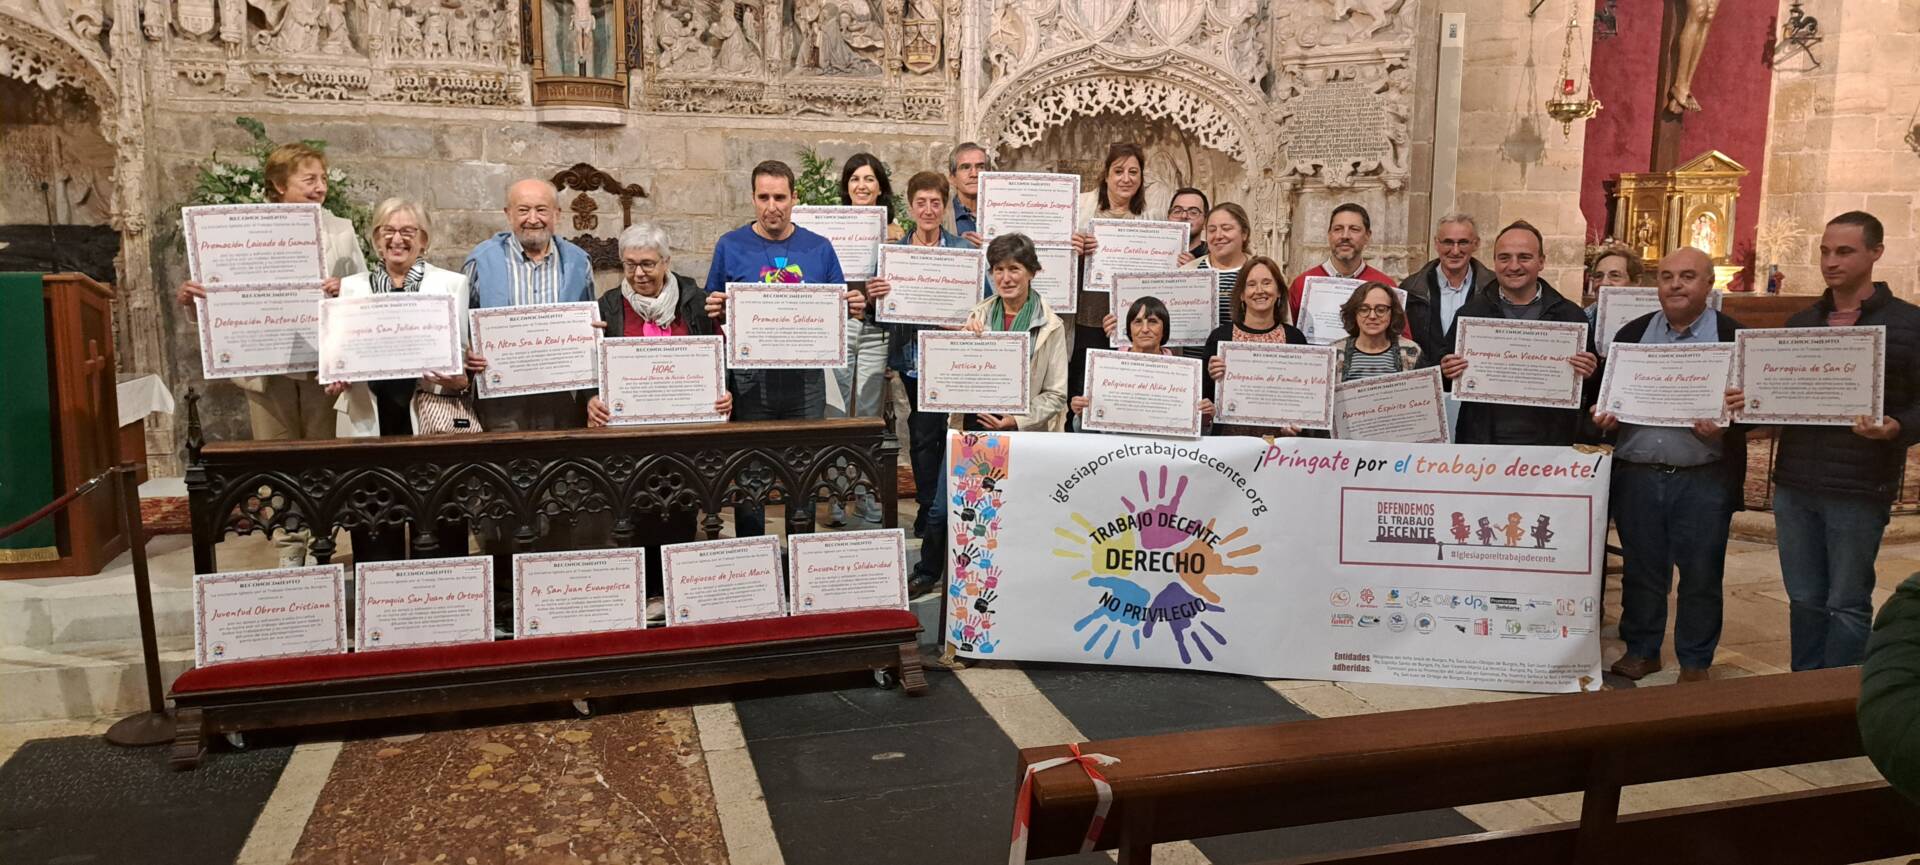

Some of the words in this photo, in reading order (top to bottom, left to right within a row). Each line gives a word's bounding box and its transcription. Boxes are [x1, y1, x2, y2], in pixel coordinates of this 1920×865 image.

[201, 239, 244, 250] Promoción
[246, 238, 276, 249] Laicado
[277, 239, 286, 247] de
[214, 316, 262, 328] Delegación
[264, 314, 299, 325] Pastoral
[300, 313, 319, 324] Gitan
[752, 313, 791, 324] Promoción
[376, 324, 393, 334] San
[544, 335, 561, 346] Real
[566, 334, 593, 344] Antigua
[1465, 347, 1501, 359] Parroquia
[1503, 350, 1518, 360] San
[1520, 351, 1549, 361] Vicente
[651, 364, 676, 375] HOAC
[951, 361, 976, 371] Justicia
[978, 364, 983, 372] y
[984, 361, 997, 370] Paz
[1763, 362, 1808, 375] Parroquia
[1810, 363, 1820, 373] de
[1823, 362, 1840, 374] San
[1843, 362, 1857, 373] Gil
[1102, 378, 1135, 391] Religiosas
[1137, 380, 1148, 390] del
[1226, 371, 1265, 382] Delegación
[1310, 376, 1326, 385] Vida
[1664, 374, 1673, 382] de
[1675, 372, 1710, 383] Pastoral
[1342, 408, 1376, 420] Parroquia
[1408, 399, 1431, 409] Santo
[1253, 445, 1351, 479] ¡Príngate
[1354, 455, 1388, 478] por
[1394, 454, 1412, 474] el
[1416, 455, 1497, 482] trabajo
[1504, 454, 1603, 479] decente!
[1049, 441, 1268, 517] iglesiaporeltrabajodecente.org
[1377, 501, 1435, 517] DEFENDEMOS
[1377, 515, 1389, 525] EL
[1391, 515, 1434, 526] TRABAJO
[1088, 511, 1154, 546] TRABAJO
[1157, 512, 1222, 549] DECENTE
[1378, 525, 1435, 540] DECENTE
[807, 564, 845, 574] Encuentro
[853, 561, 893, 572] Solidaridad
[1105, 547, 1206, 575] DERECHO
[680, 575, 716, 585] Religiosas
[717, 573, 727, 581] de
[728, 570, 746, 582] Jesús
[748, 567, 770, 577] María
[546, 585, 562, 595] San
[563, 584, 583, 595] Juan
[585, 581, 631, 592] Evangelista
[367, 596, 405, 607] Parroquia
[407, 593, 423, 604] San
[423, 593, 443, 605] Juan
[445, 592, 455, 601] de
[457, 591, 484, 601] Ortega
[210, 608, 252, 621] Juventud
[254, 604, 286, 616] Obrera
[288, 601, 331, 612] Cristiana
[1098, 591, 1121, 613] NO
[1122, 597, 1208, 623] PRIVILEGIO
[1334, 651, 1371, 662] Entidades
[1332, 663, 1372, 673] adheridas:
